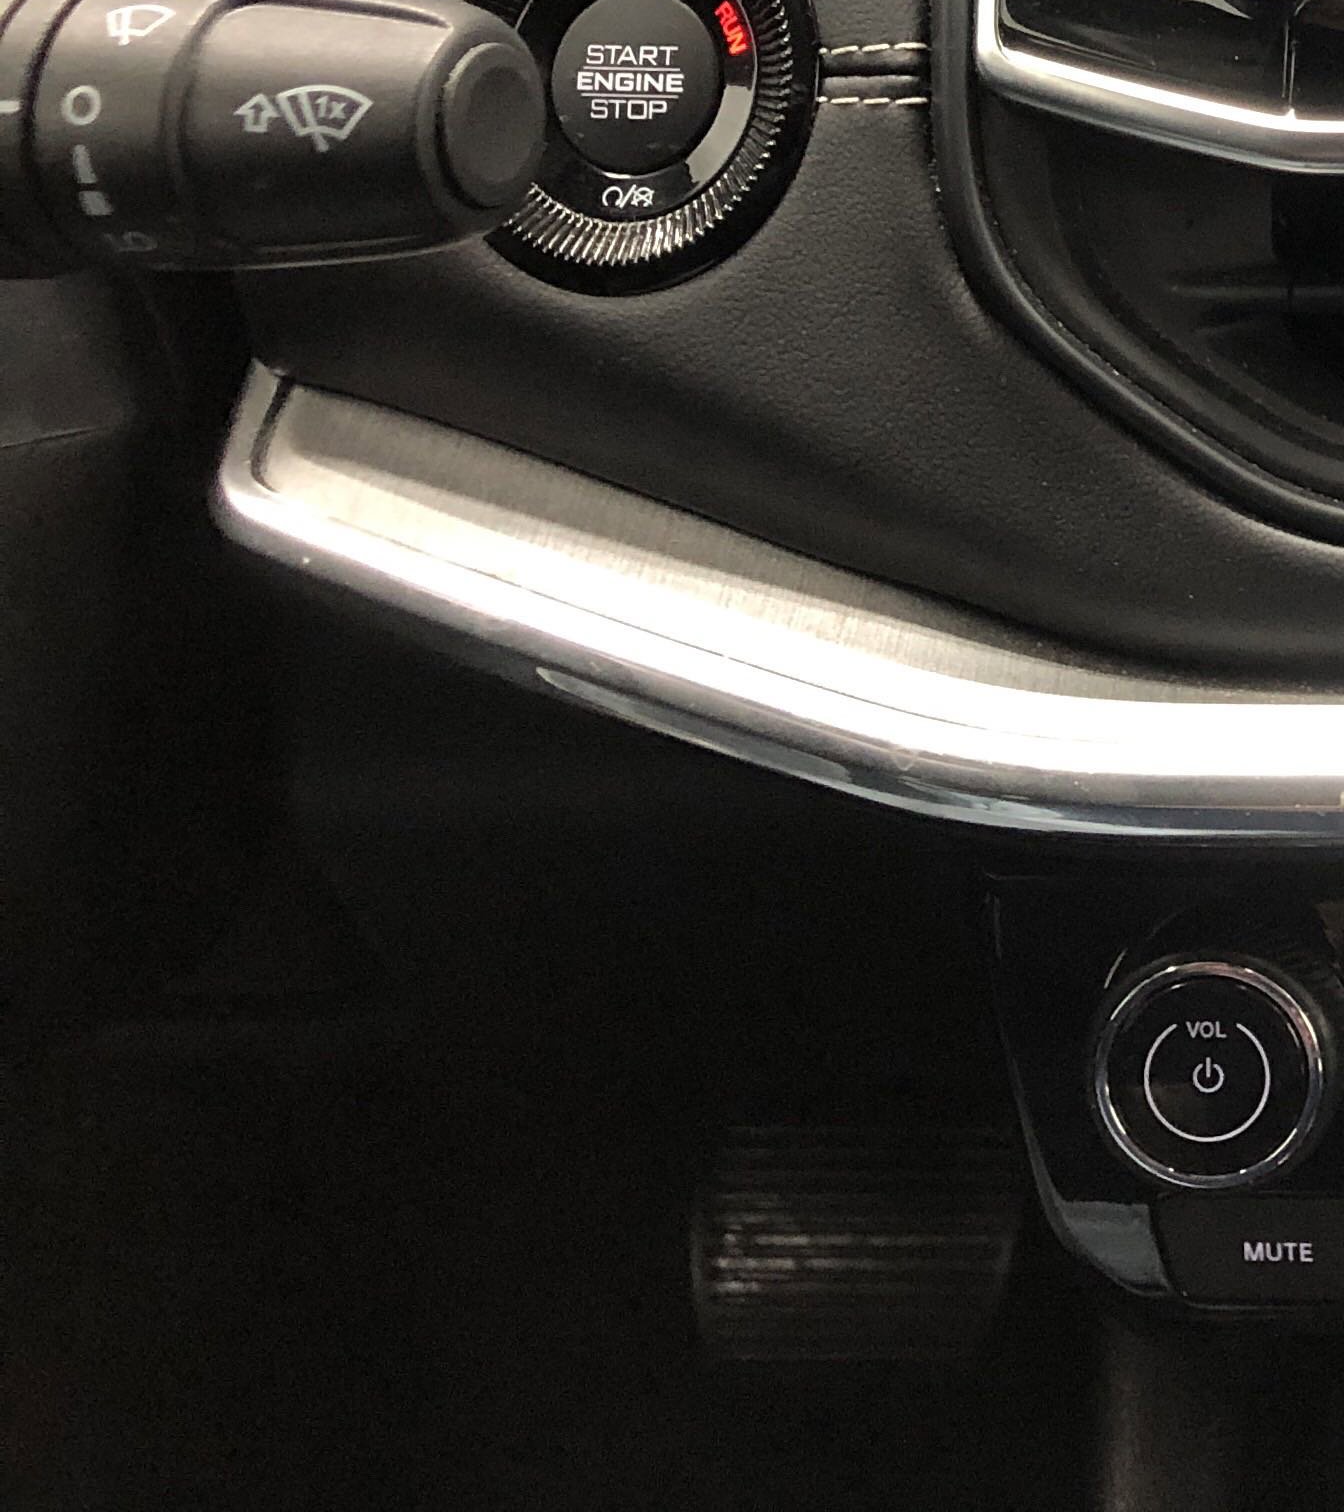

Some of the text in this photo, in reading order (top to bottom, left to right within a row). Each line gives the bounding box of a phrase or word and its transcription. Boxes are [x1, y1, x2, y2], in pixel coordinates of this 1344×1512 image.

[714, 0, 748, 56] RUN
[586, 45, 678, 65] START
[577, 71, 684, 93] ENGINE
[589, 99, 667, 119] STOP
[1186, 1021, 1227, 1039] VOL
[1243, 1242, 1313, 1262] MUTE
